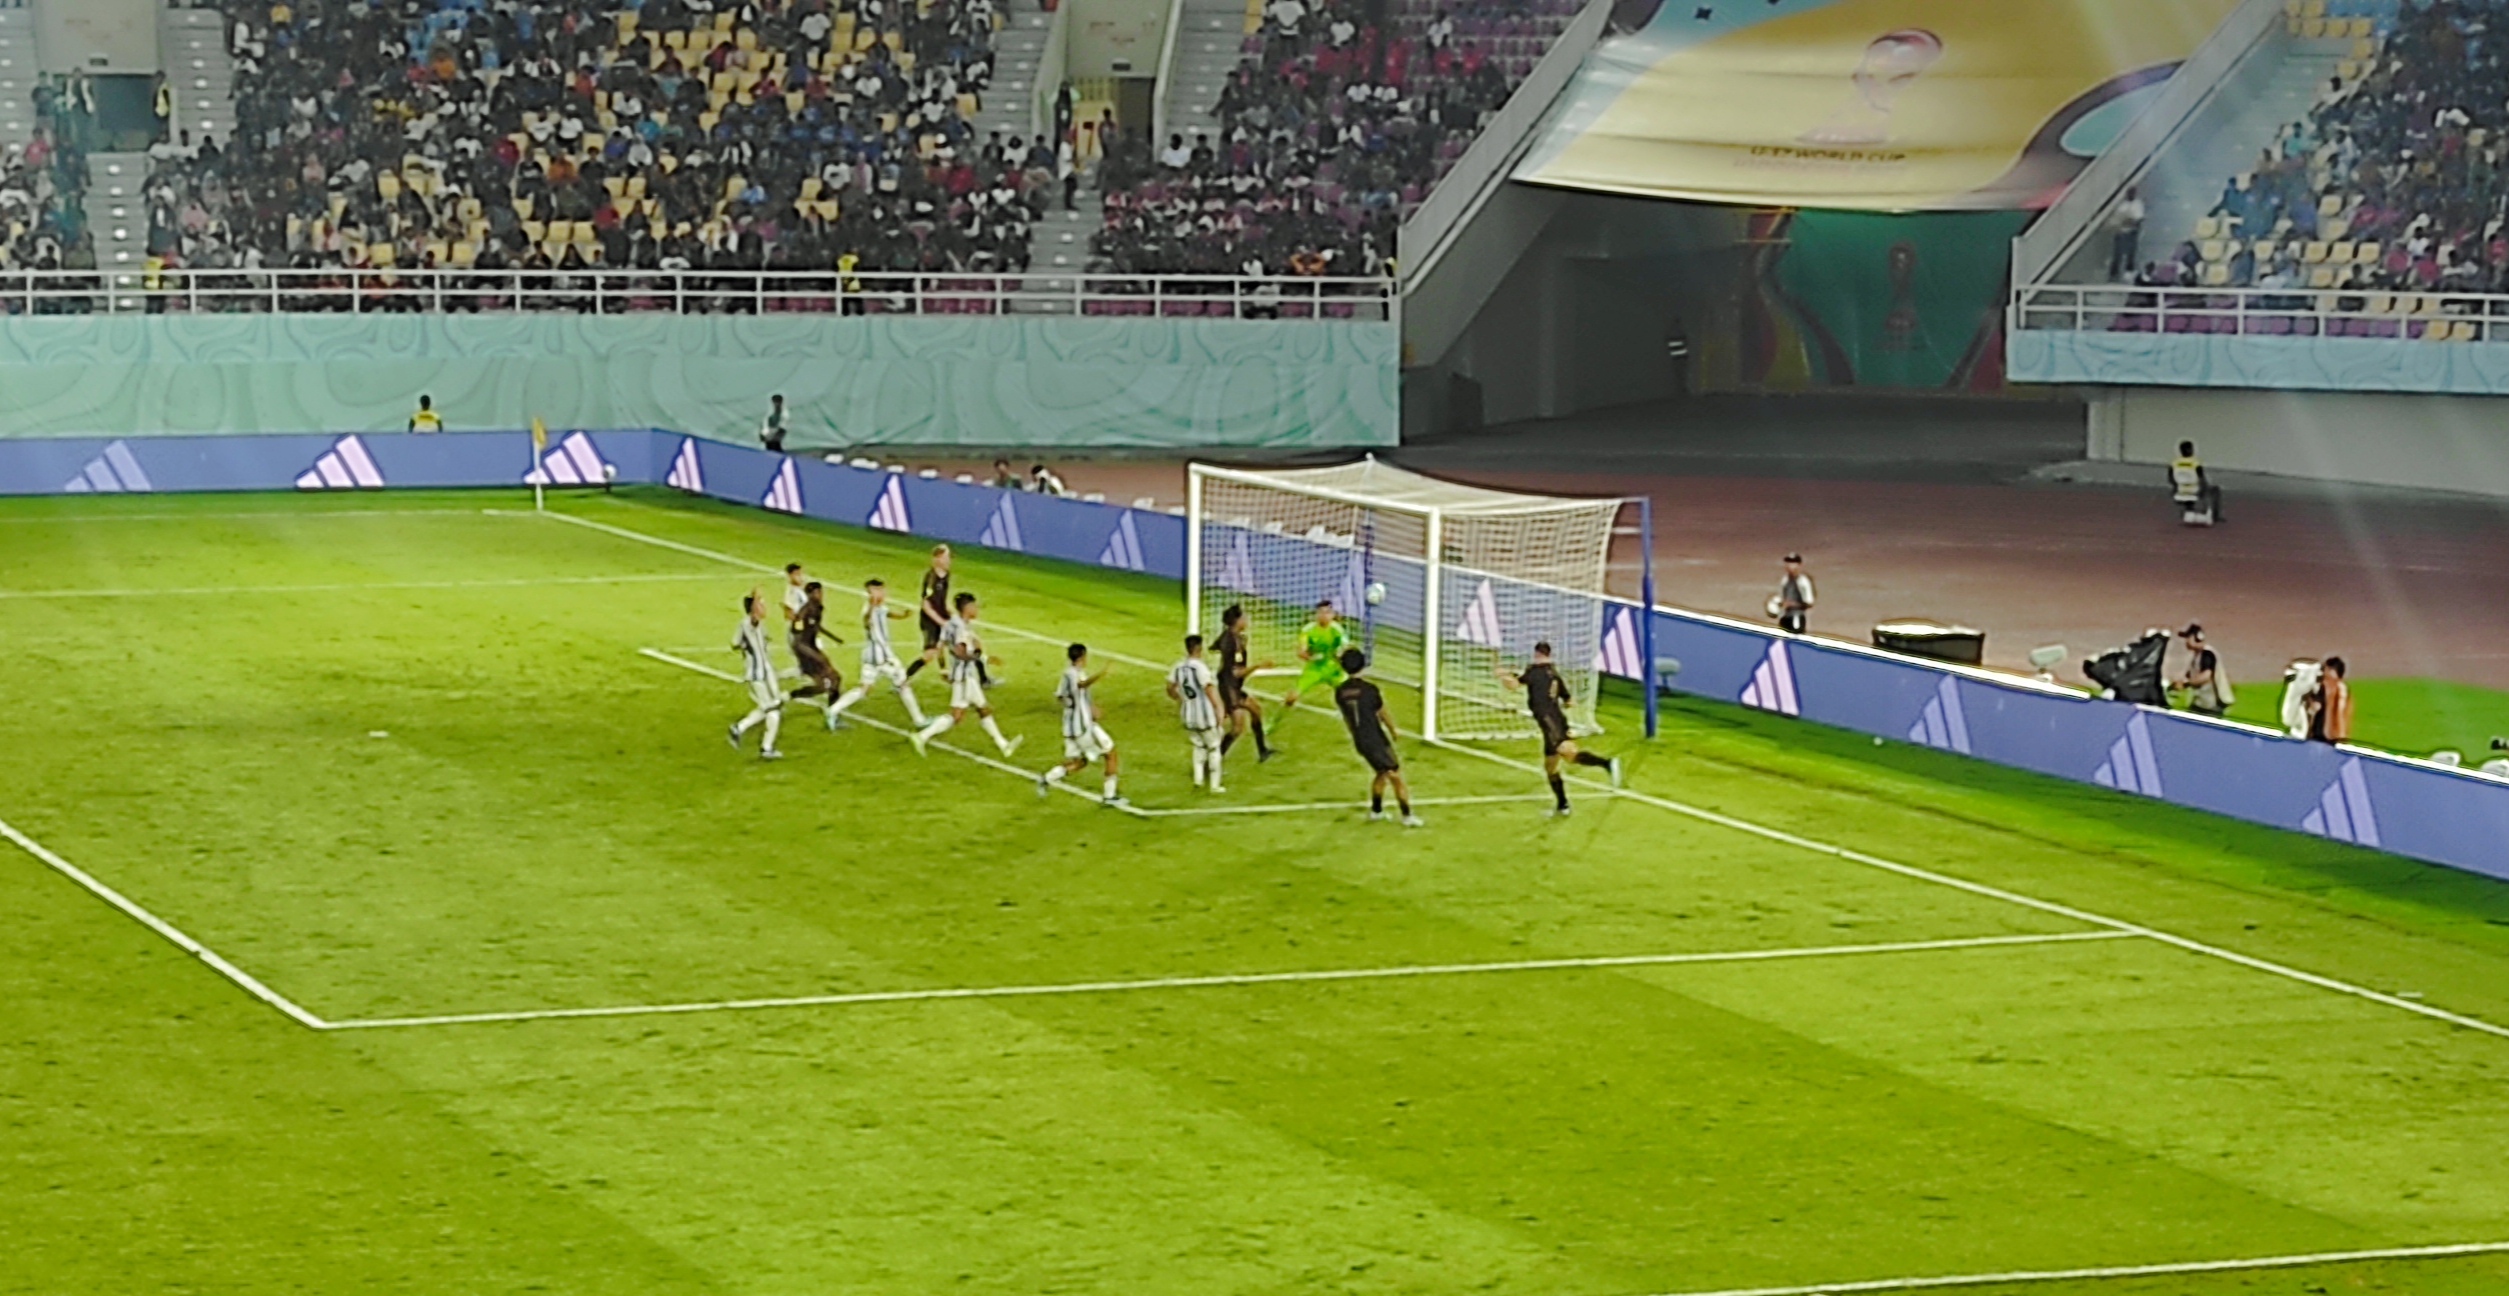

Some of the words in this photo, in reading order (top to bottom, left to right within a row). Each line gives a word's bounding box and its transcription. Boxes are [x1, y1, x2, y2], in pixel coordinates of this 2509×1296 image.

[1795, 149, 1863, 161] WORLD
[1867, 152, 1906, 162] CUP
[1182, 677, 1198, 700] 6
